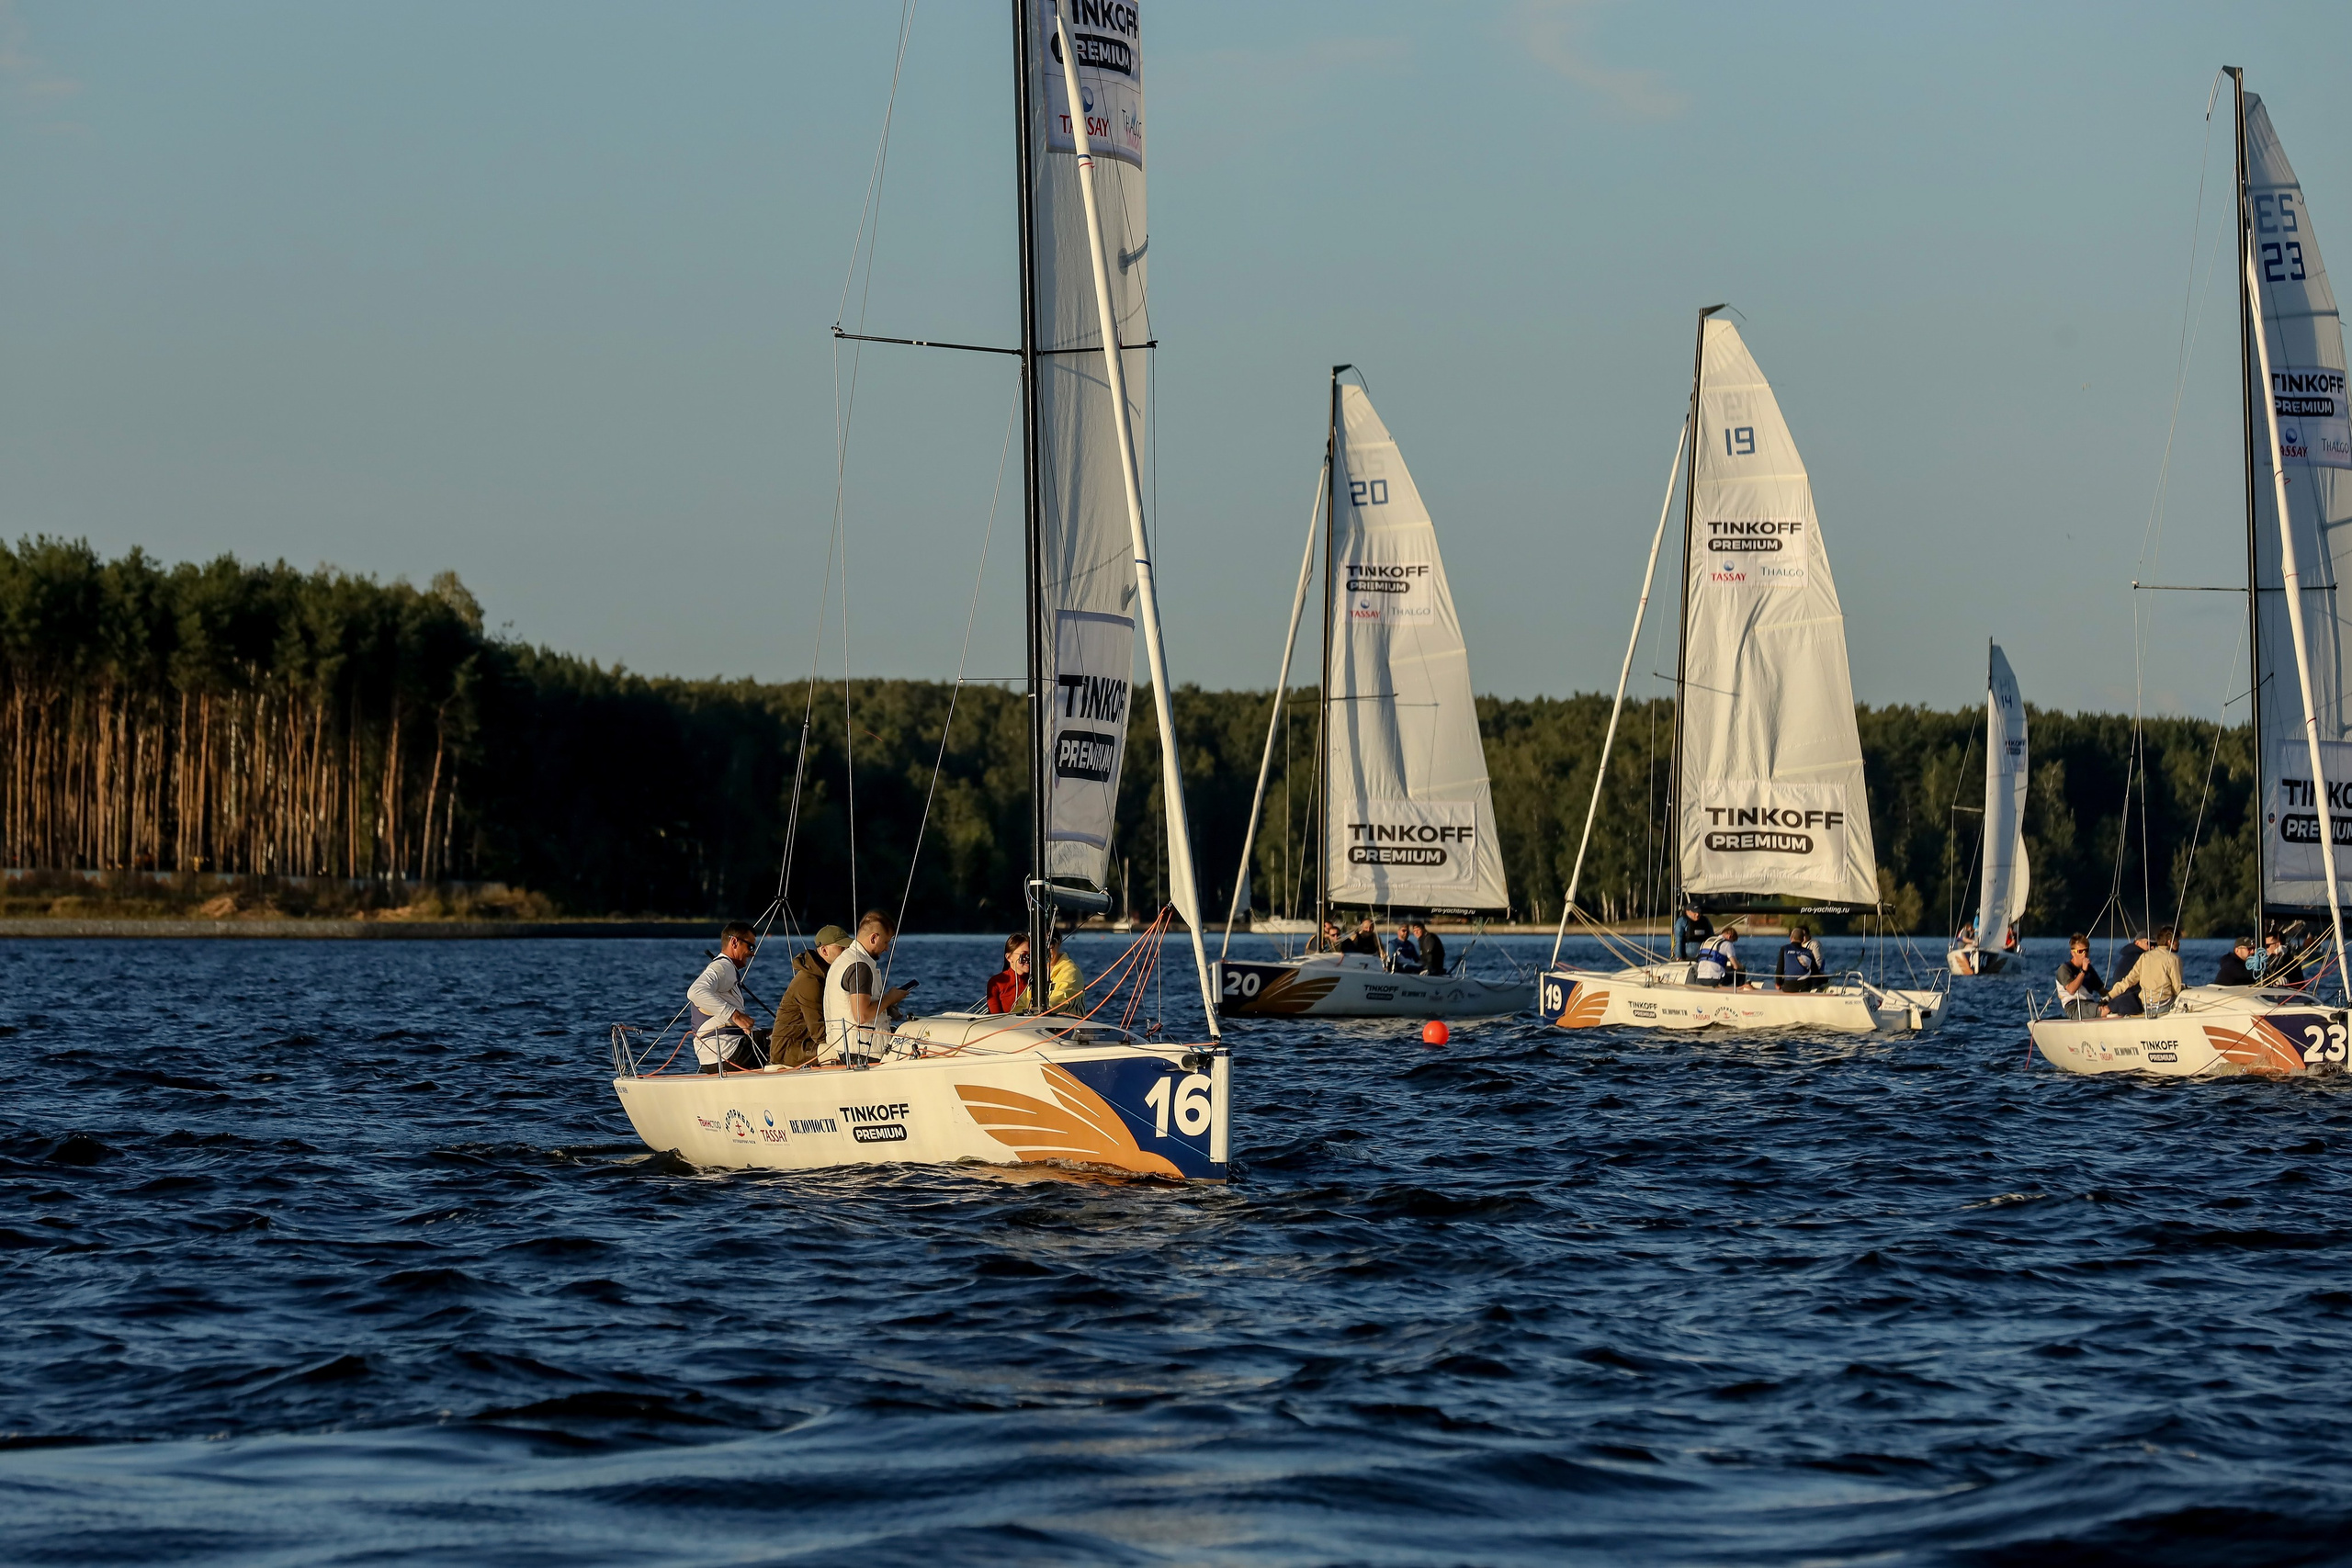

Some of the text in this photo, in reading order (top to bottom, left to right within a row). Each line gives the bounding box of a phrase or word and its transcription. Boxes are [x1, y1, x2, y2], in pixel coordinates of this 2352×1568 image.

[1049, 0, 1138, 39] INKOFF
[1058, 38, 1130, 71] REMIUM
[1059, 114, 1110, 137] TSAY
[2261, 242, 2306, 283] 23
[2271, 372, 2345, 394] TINKOFF
[1724, 426, 1756, 457] 19
[2322, 437, 2350, 454] THALGO
[2279, 445, 2309, 458] ASSAY
[1350, 479, 1389, 507] 20
[1707, 522, 1803, 536] TINKOFF
[1711, 539, 1781, 551] PREMIUM
[1346, 565, 1430, 578] TINKOFF
[1711, 572, 1747, 582] TASSAY
[1760, 566, 1804, 578] THALGO
[1349, 581, 1408, 592] PREMIUM
[1350, 610, 1381, 618] TASSAY
[1391, 606, 1431, 617] THALGO
[2001, 694, 2013, 709] 14
[1058, 739, 1114, 773] PREMIUM
[1705, 807, 1844, 830] TINKOFF
[1348, 823, 1474, 844] TINKOFF
[1711, 833, 1808, 852] PREMIUM
[1351, 848, 1443, 864] PREMIUM
[1430, 907, 1476, 916] pro-yachting.ru
[1800, 906, 1850, 915] pro-yachting.ru
[1223, 971, 1261, 997] 20
[1363, 984, 1400, 993] TINKOFF
[1545, 983, 1563, 1011] 19
[1628, 1000, 1658, 1010] TINKOFF
[2140, 1040, 2179, 1051] TINKOFF
[2303, 1024, 2347, 1063] 23
[2149, 1053, 2177, 1062] PREMIUM
[839, 1103, 910, 1123] TINKOFF
[1145, 1074, 1213, 1138] 16
[789, 1118, 837, 1135] ВЕДОМОСТИ
[854, 1126, 906, 1142] PREMIUM
[760, 1129, 788, 1143] TASSAY
